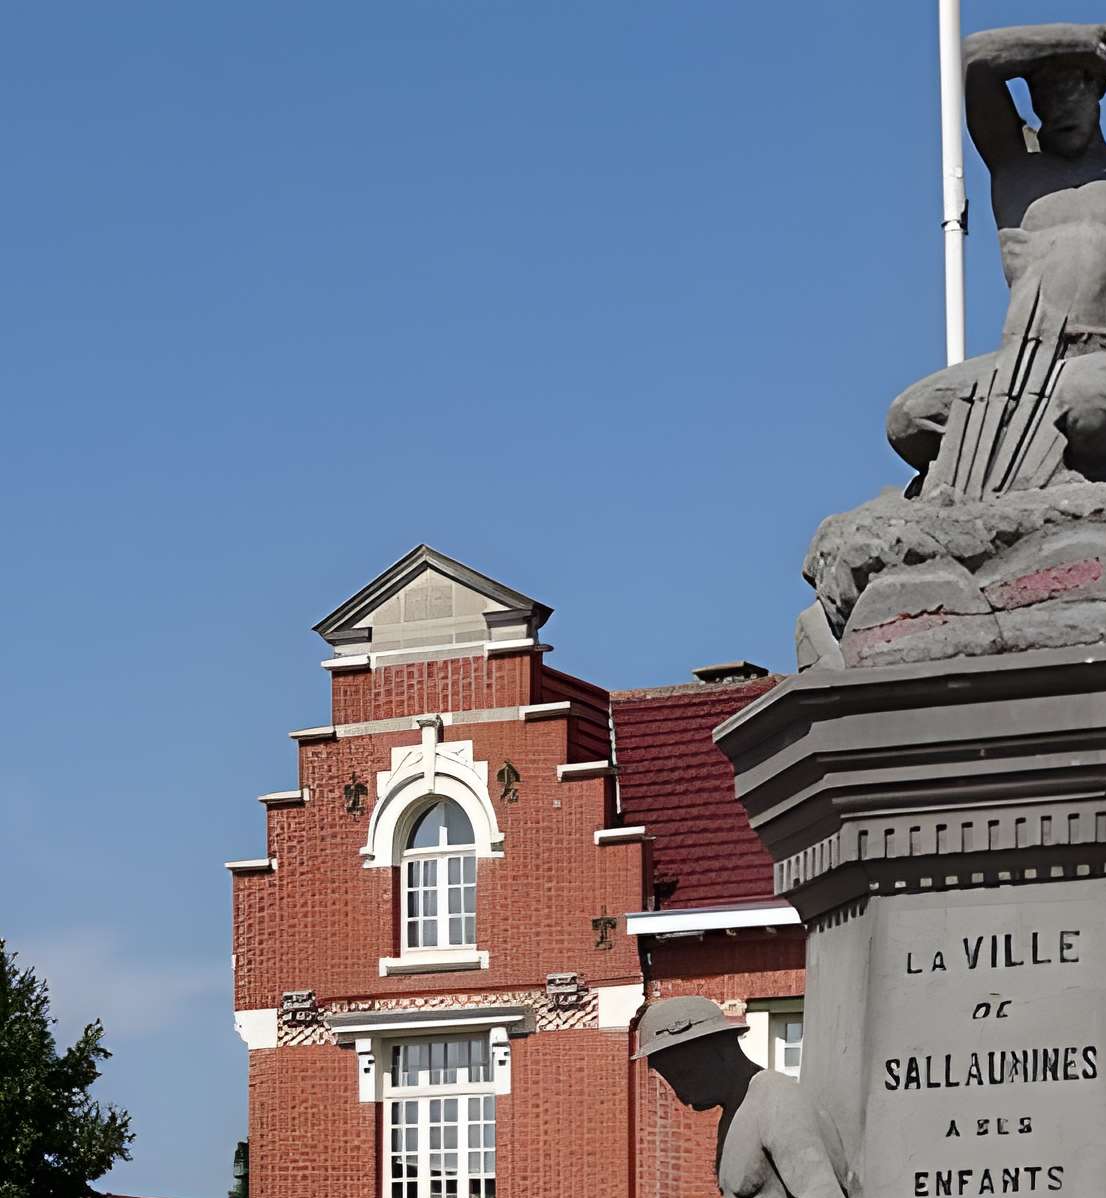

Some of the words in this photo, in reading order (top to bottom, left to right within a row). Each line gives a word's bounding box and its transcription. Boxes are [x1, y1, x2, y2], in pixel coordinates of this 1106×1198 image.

[907, 951, 946, 974] LA
[963, 930, 1080, 969] VILLE
[973, 1000, 1012, 1019] DE
[885, 1046, 1097, 1090] SALLAUMINES
[976, 1117, 1032, 1136] SES
[915, 1166, 1064, 1197] ENFANTS
